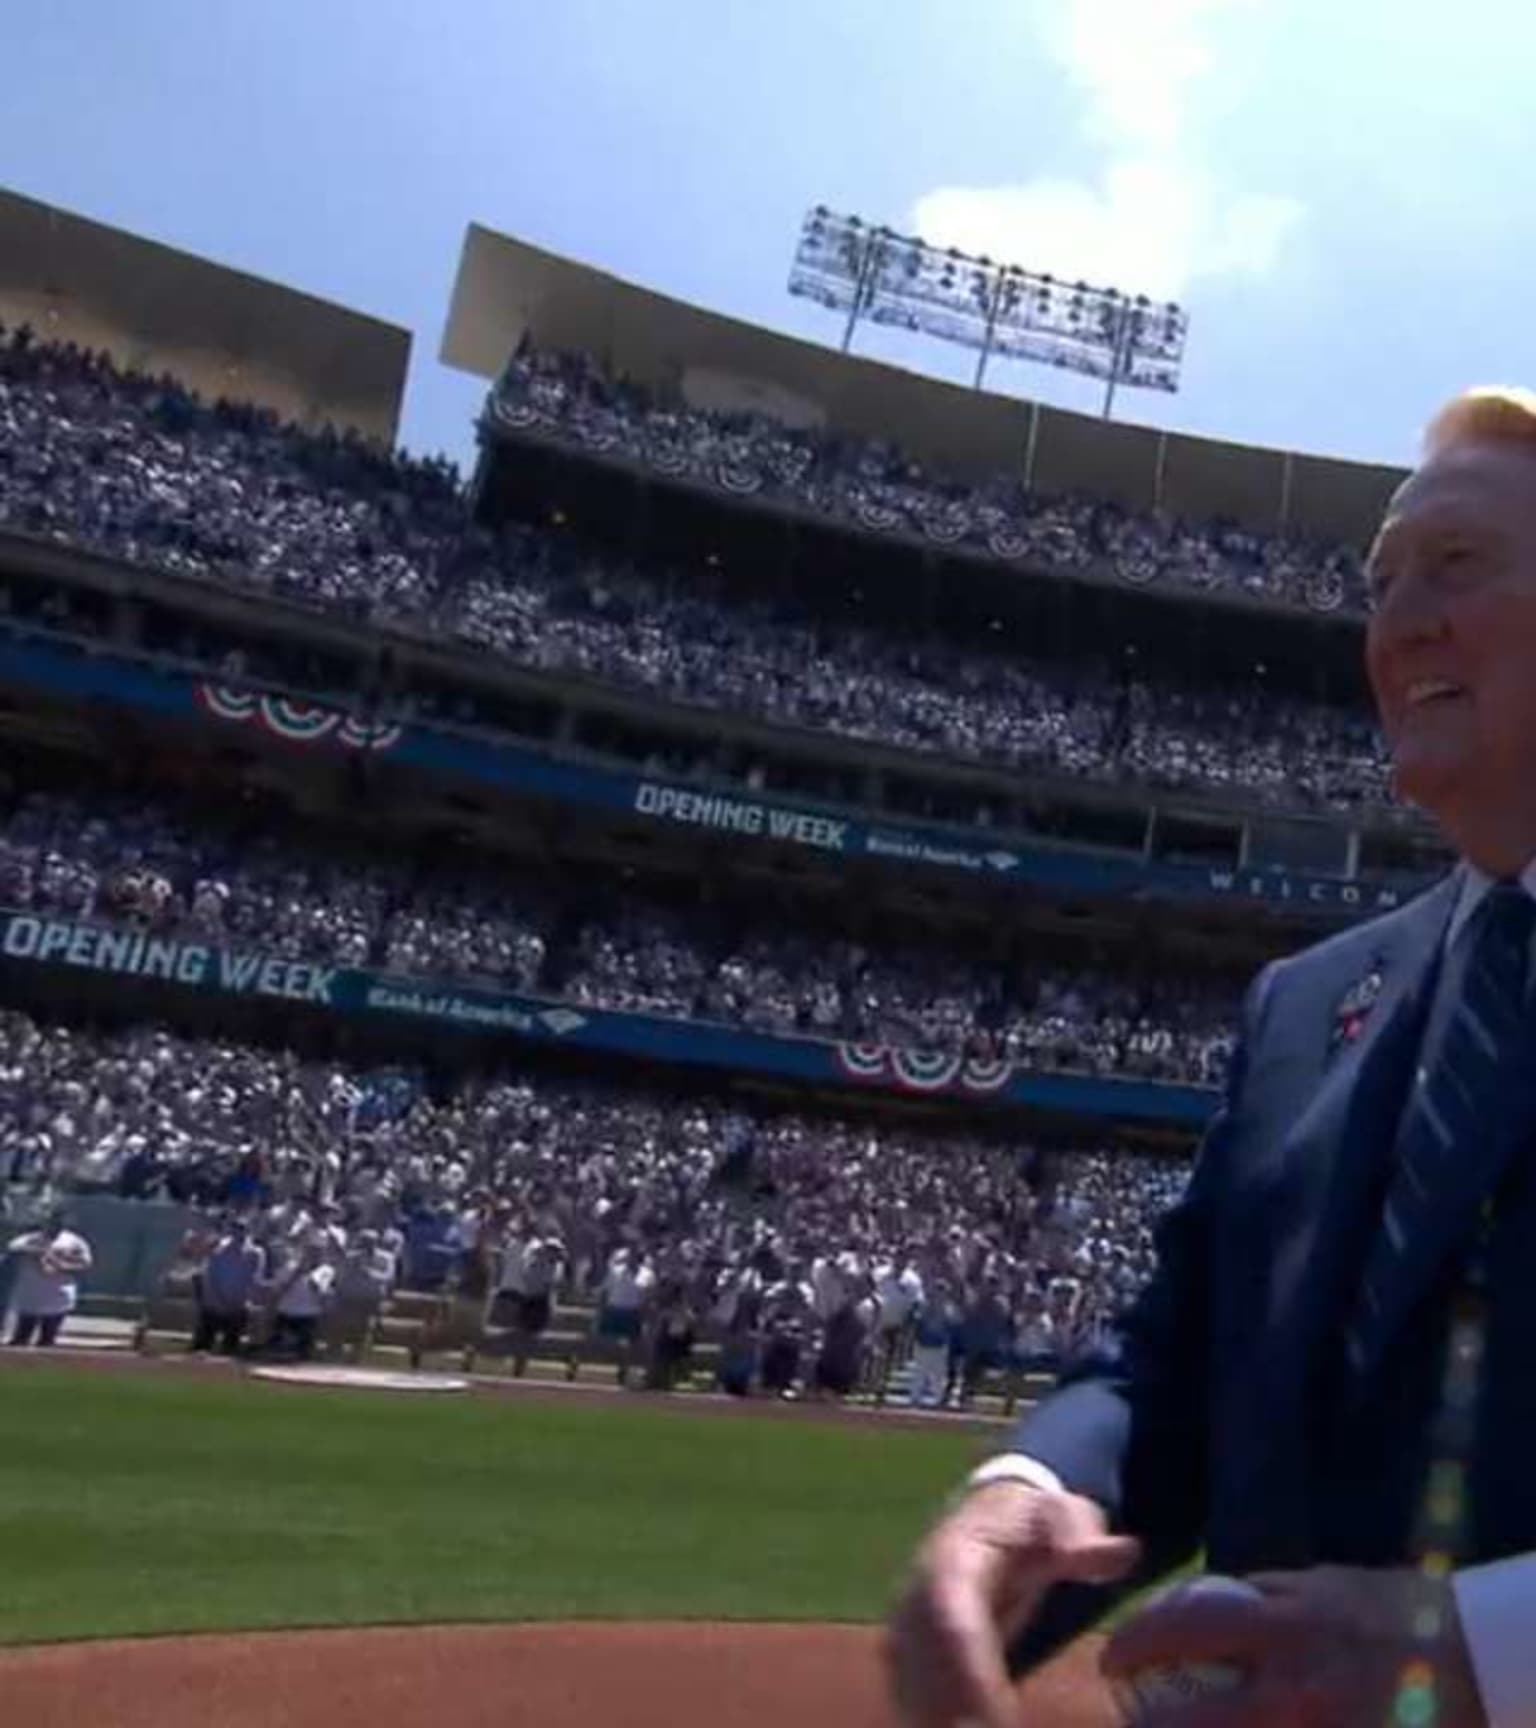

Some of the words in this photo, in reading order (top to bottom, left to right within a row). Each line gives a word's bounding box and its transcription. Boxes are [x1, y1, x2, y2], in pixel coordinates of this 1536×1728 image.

[635, 782, 763, 834] OPENING
[770, 810, 846, 850] WEEK
[1210, 868, 1395, 905] WELCOM
[3, 917, 210, 983] OPENING
[219, 951, 336, 1004] WEEK
